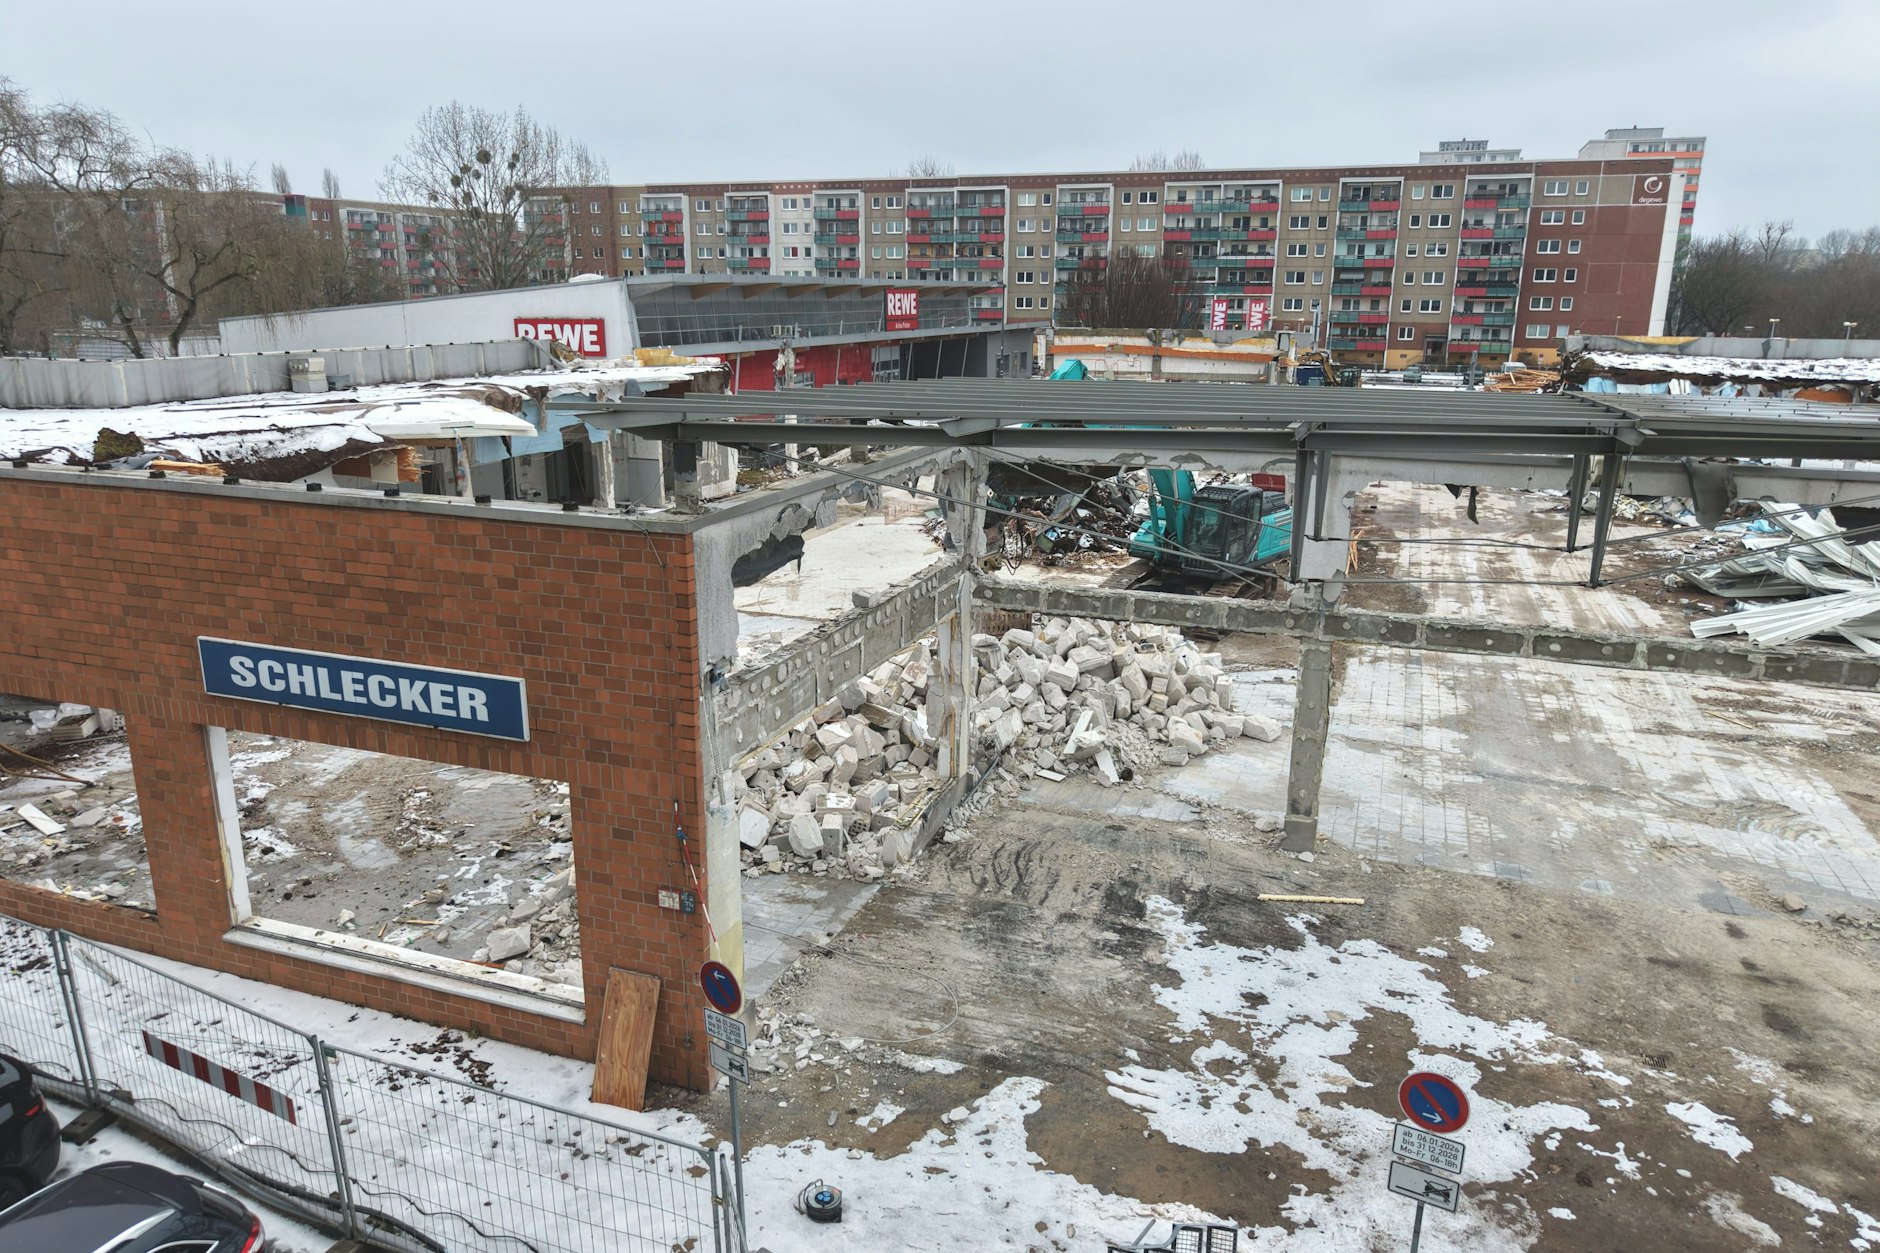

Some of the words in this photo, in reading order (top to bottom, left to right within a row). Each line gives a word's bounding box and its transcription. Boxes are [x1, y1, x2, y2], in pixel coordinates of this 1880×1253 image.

[1638, 196, 1663, 205] degewo
[887, 293, 917, 316] REWE
[229, 655, 490, 722] SCHLECKER
[1402, 1130, 1413, 1138] ab
[1417, 1133, 1460, 1153] 06.01.2026
[1402, 1137, 1415, 1147] bis
[1416, 1141, 1458, 1161] 31.12.2028
[1399, 1144, 1426, 1159] Mo-Fr
[1429, 1154, 1458, 1170] 06-18h
